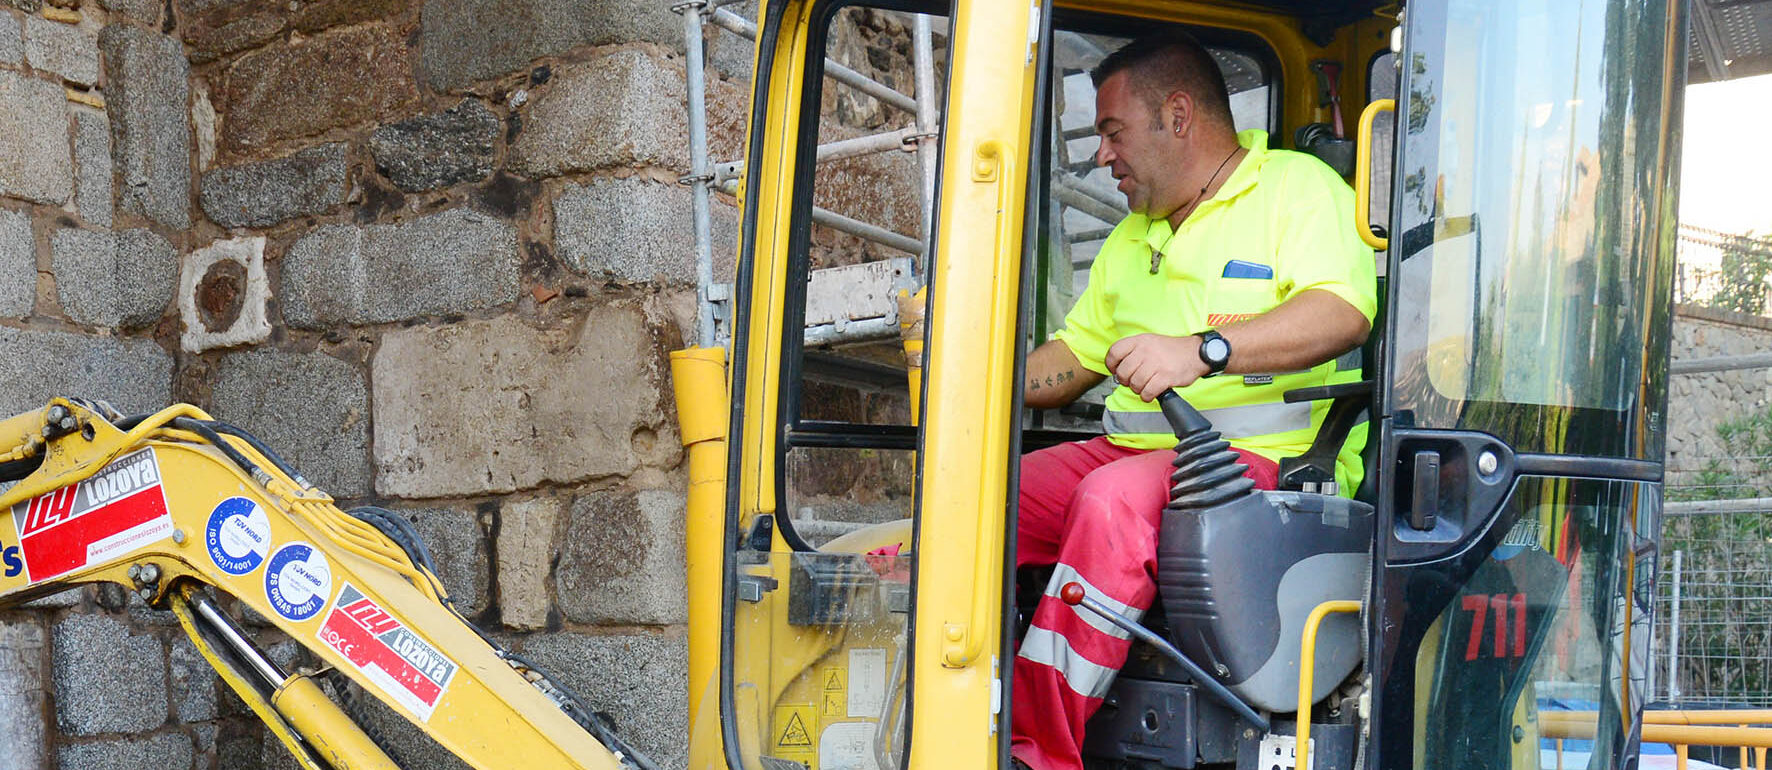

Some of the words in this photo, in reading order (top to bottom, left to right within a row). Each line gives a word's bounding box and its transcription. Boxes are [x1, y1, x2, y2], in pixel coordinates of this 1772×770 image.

[208, 528, 217, 544] ISO
[211, 547, 252, 571] 9001/14001
[270, 573, 279, 585] BS
[270, 587, 291, 614] OHSAS
[293, 600, 316, 615] 18001
[1462, 593, 1526, 661] 711
